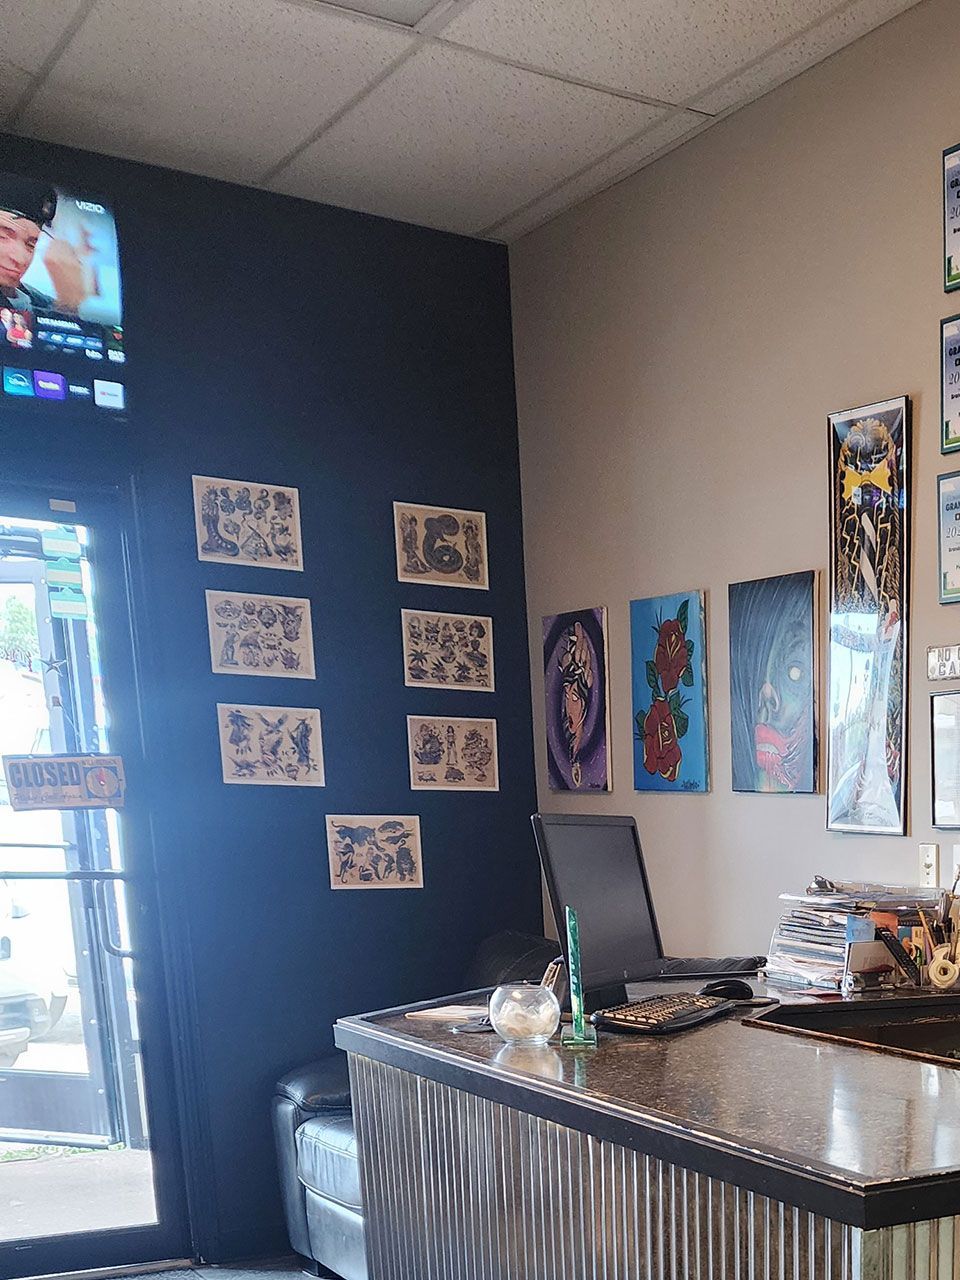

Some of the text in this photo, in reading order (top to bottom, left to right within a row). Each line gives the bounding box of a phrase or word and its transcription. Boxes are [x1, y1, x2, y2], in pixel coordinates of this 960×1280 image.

[75, 200, 106, 214] VIZIO
[937, 648, 950, 662] NO
[9, 762, 81, 788] CLOSED
